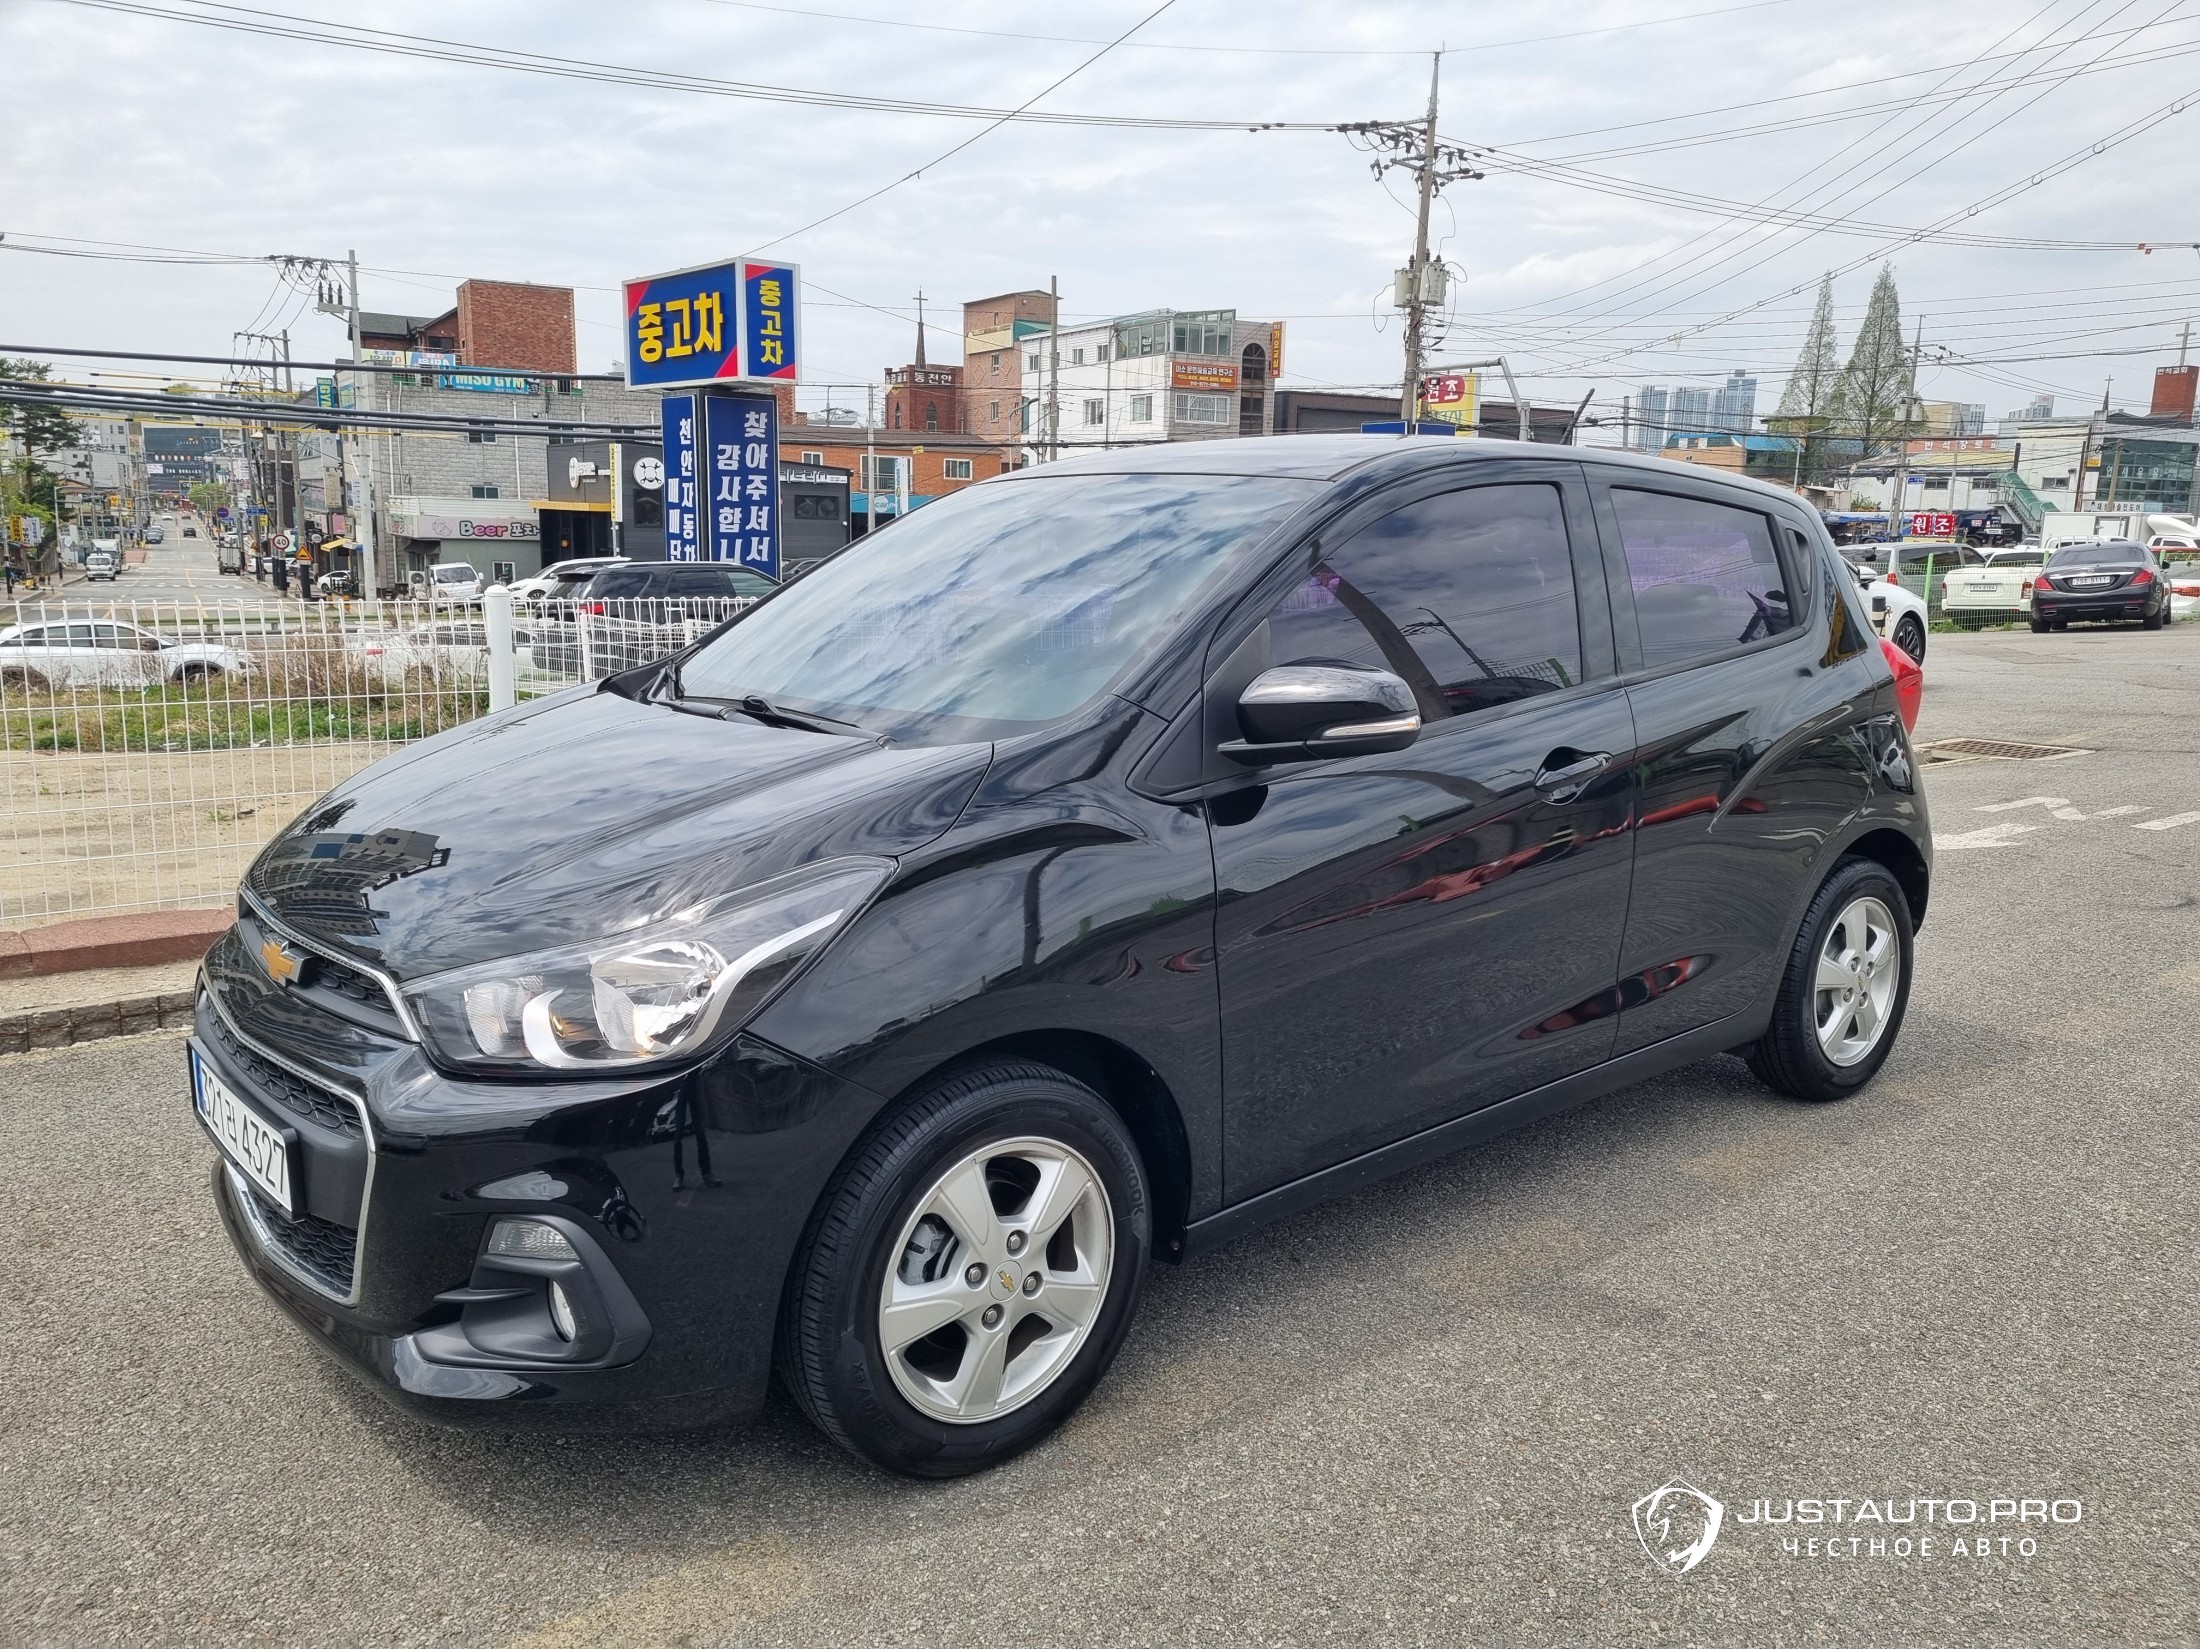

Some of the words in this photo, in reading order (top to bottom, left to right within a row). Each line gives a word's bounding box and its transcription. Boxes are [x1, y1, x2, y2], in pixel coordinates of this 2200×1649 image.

[638, 291, 724, 363] 중고차
[759, 279, 784, 366] 중고차
[914, 371, 953, 385] 동천안
[679, 418, 696, 562] 천안자동차
[716, 444, 743, 564] 감사합니
[744, 411, 770, 562] 찾아주셔서
[276, 537, 287, 547] 40
[459, 520, 508, 537] Beer
[510, 521, 541, 538] 포차
[1913, 516, 1950, 534] 원조
[242, 1113, 285, 1194] 4327
